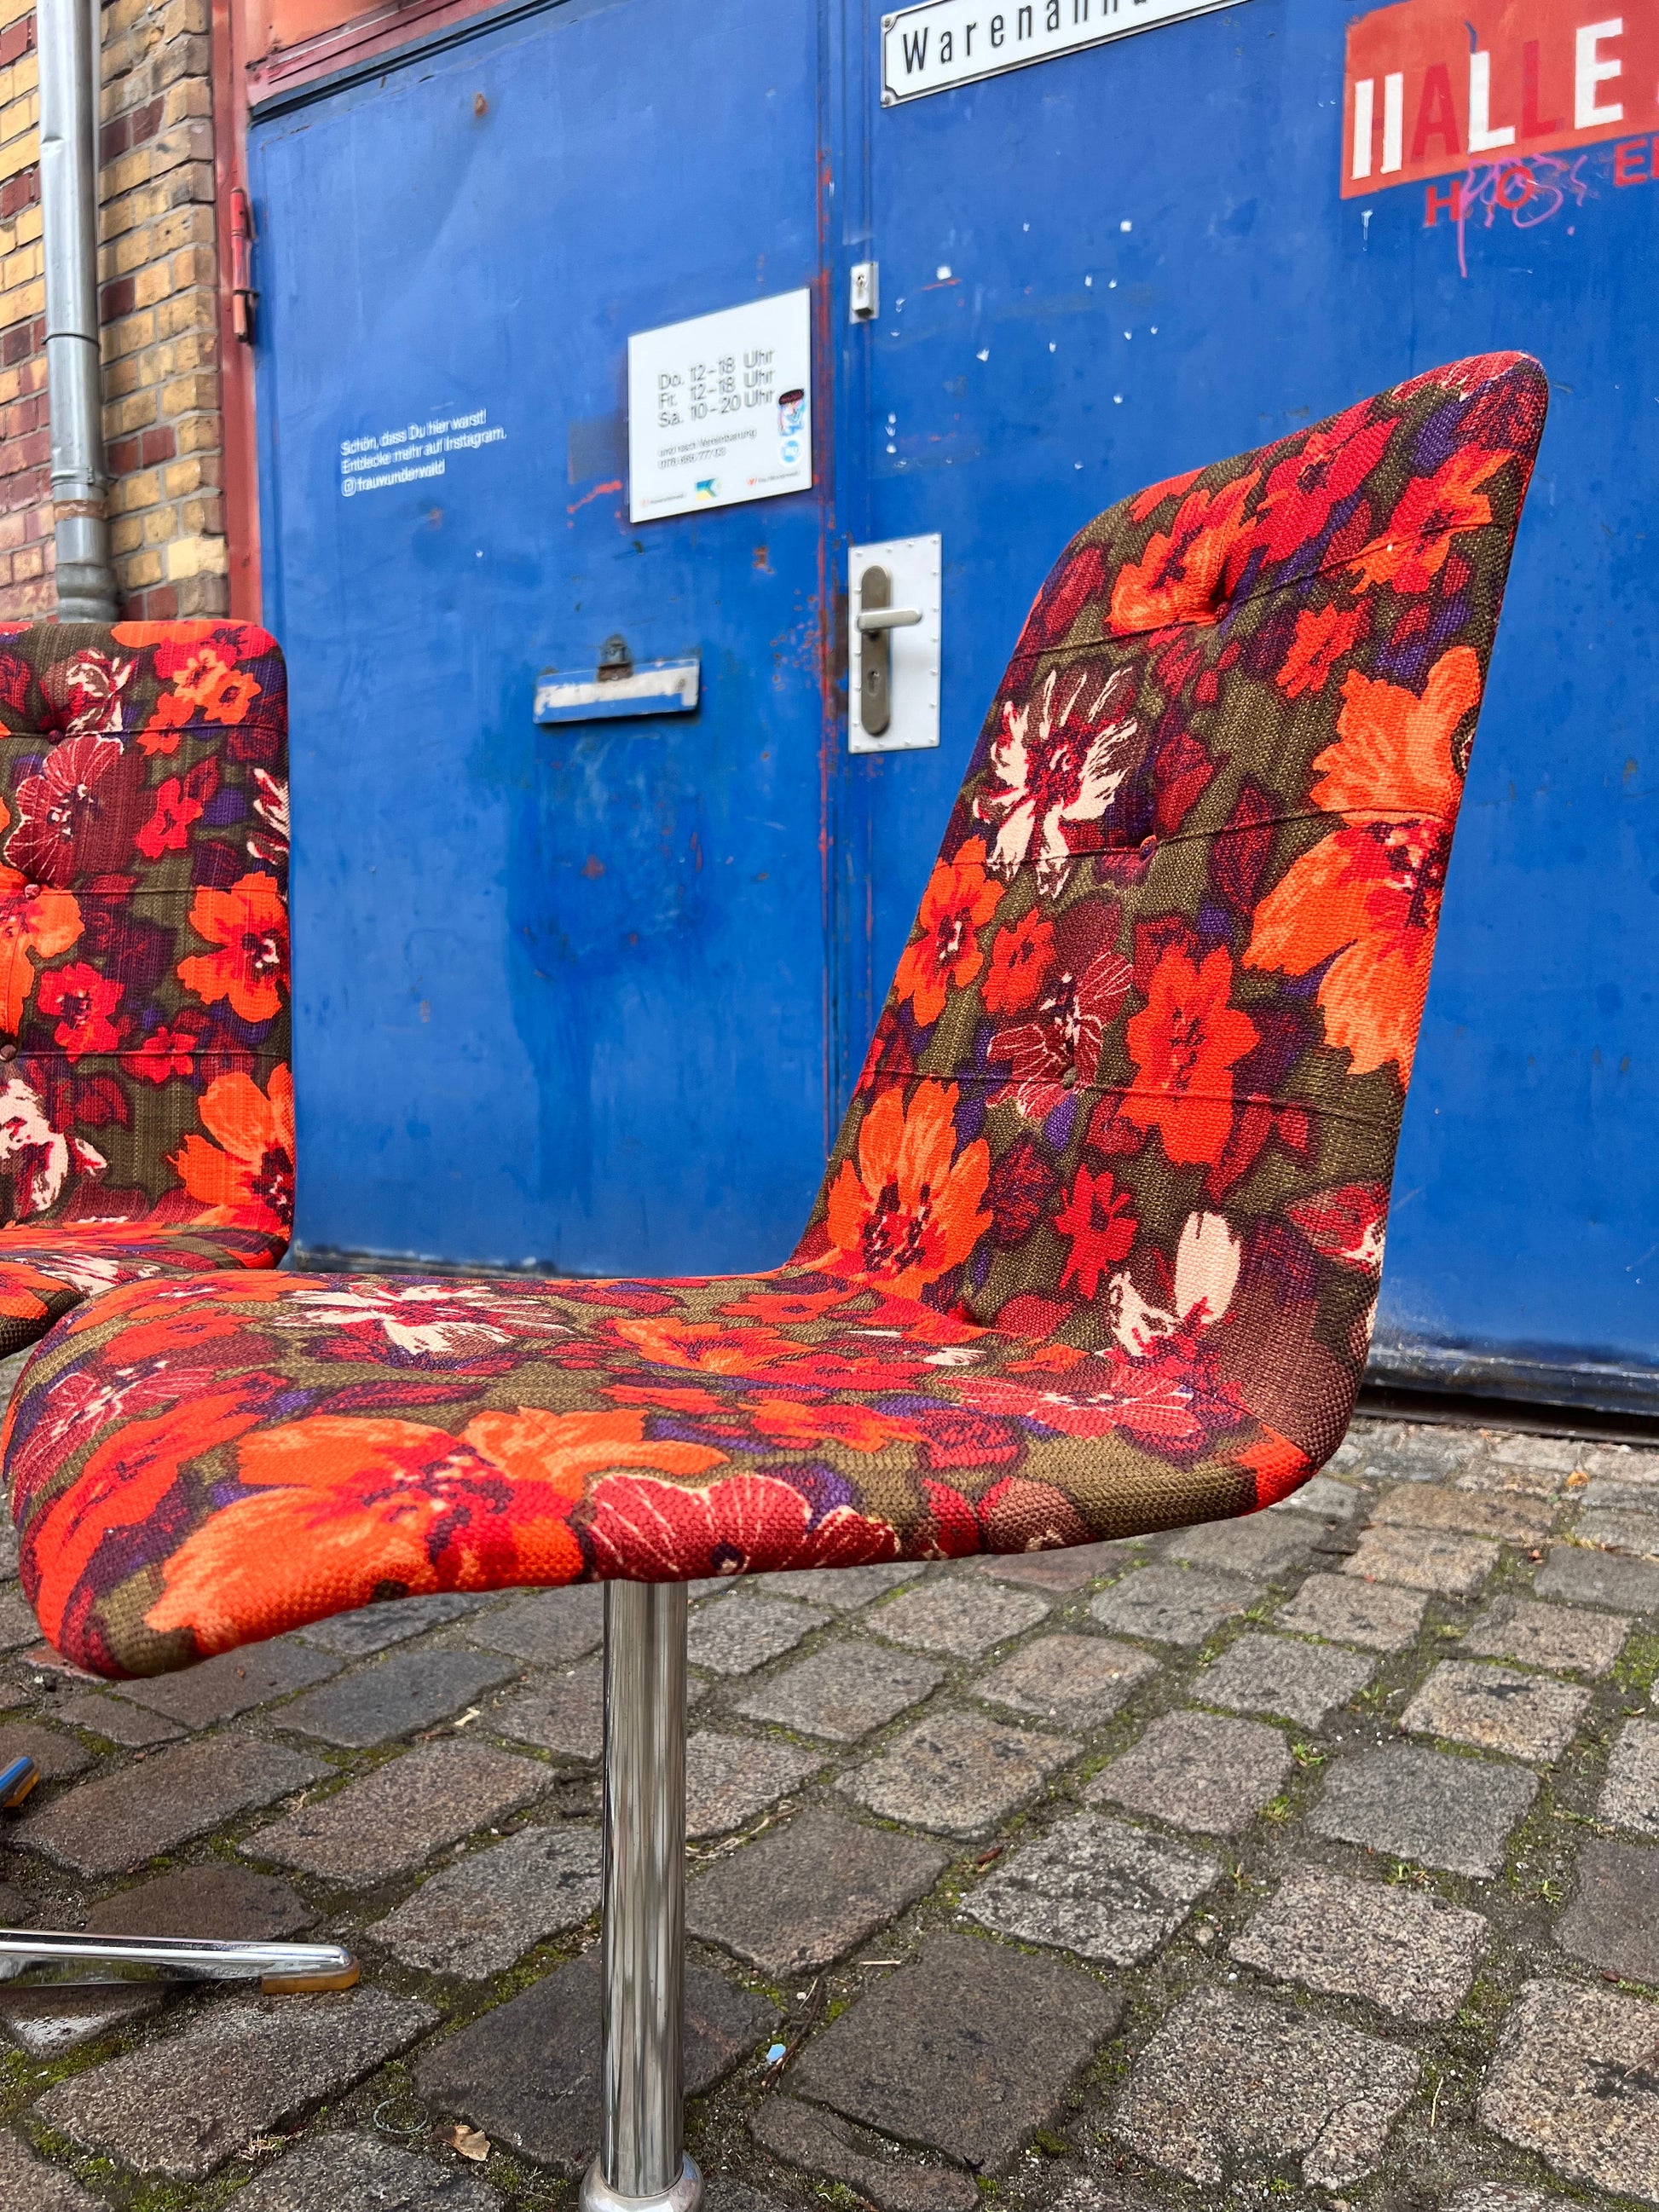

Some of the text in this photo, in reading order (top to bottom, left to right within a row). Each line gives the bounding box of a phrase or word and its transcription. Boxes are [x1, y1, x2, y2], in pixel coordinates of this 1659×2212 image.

[658, 373, 684, 390] Do.
[743, 349, 775, 368] Uhr
[658, 392, 678, 409] Fr.
[743, 369, 775, 388] Uhr
[658, 412, 684, 429] Sa.
[743, 389, 775, 407] Uhr
[340, 408, 487, 456] Schön, dass Du hier warst!
[340, 427, 507, 475] Entdecke mehr auf Instagram.
